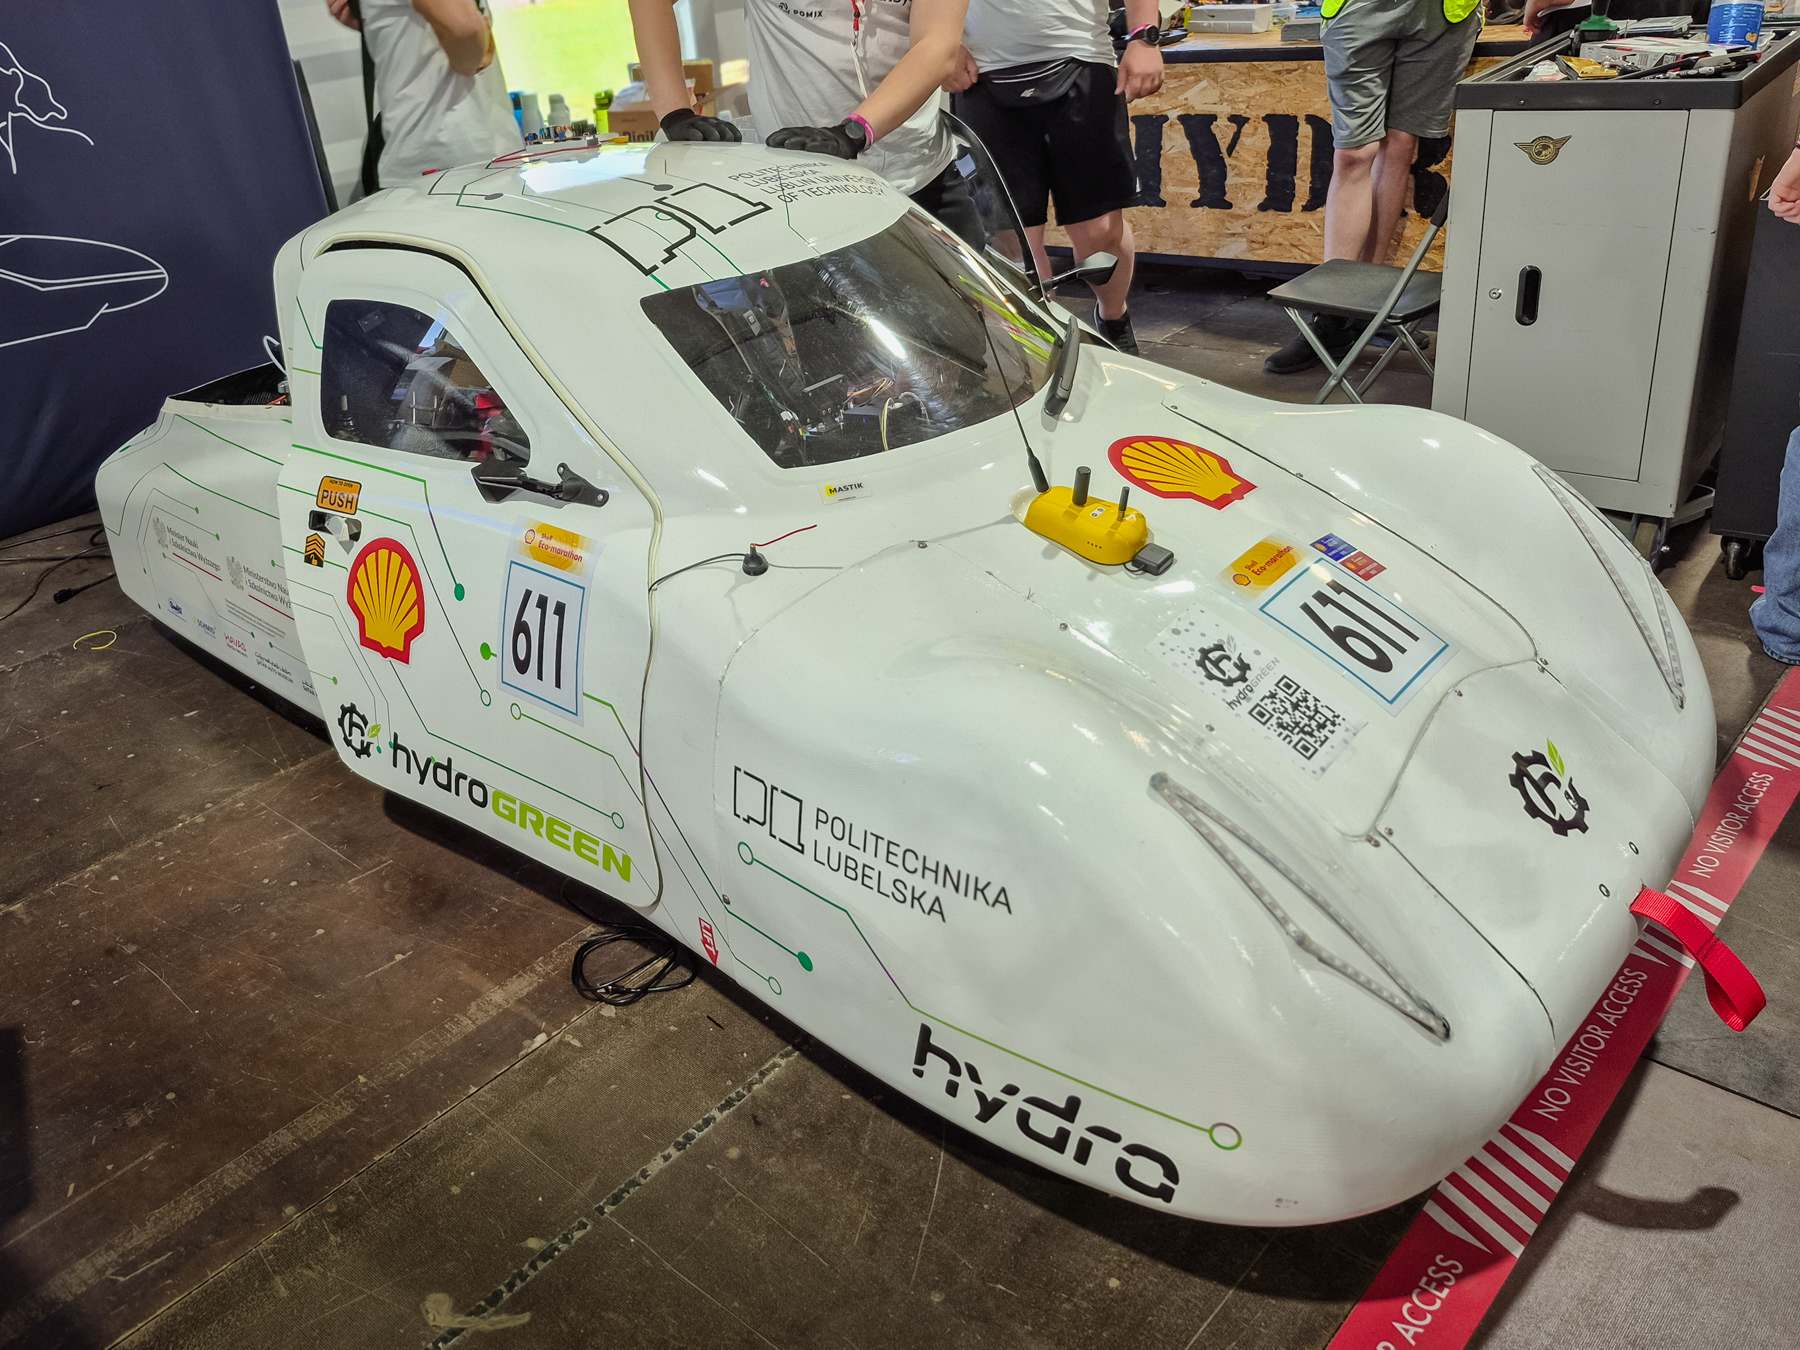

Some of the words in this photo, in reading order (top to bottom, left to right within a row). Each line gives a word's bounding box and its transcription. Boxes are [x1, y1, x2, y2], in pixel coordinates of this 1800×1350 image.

[622, 131, 656, 142] Digi
[728, 162, 832, 181] POLITECHNIKA
[744, 169, 824, 188] LUBELSKA
[760, 177, 818, 195] LUBLIN
[814, 174, 889, 189] UNIVERSITY
[777, 192, 801, 203] OF
[799, 183, 888, 198] TECHNOLOGY
[321, 489, 354, 510] PUSH
[829, 482, 864, 494] MASTIK
[166, 526, 185, 542] Minister
[185, 536, 199, 549] Nauki
[537, 540, 583, 563] Eco-marathon
[1251, 546, 1294, 576] Eco-marathon
[242, 565, 277, 590] Ministerstwo
[277, 583, 289, 596] Nau
[512, 588, 566, 690] 611
[1299, 579, 1421, 673] 611
[1226, 657, 1281, 711] hydroGREEN
[392, 731, 632, 883] hydroGREEN
[1732, 771, 1774, 814] ACCESS
[1703, 812, 1750, 854] VISITOR
[815, 807, 1013, 914] POLITECHNIKA
[1688, 855, 1720, 879] NO
[813, 839, 946, 923] LUBELSKA
[1532, 1087, 1571, 1122] NO
[1553, 1024, 1614, 1086] VISITOR
[1595, 967, 1648, 1027] ACCESS
[1391, 1254, 1463, 1346] ACCESS
